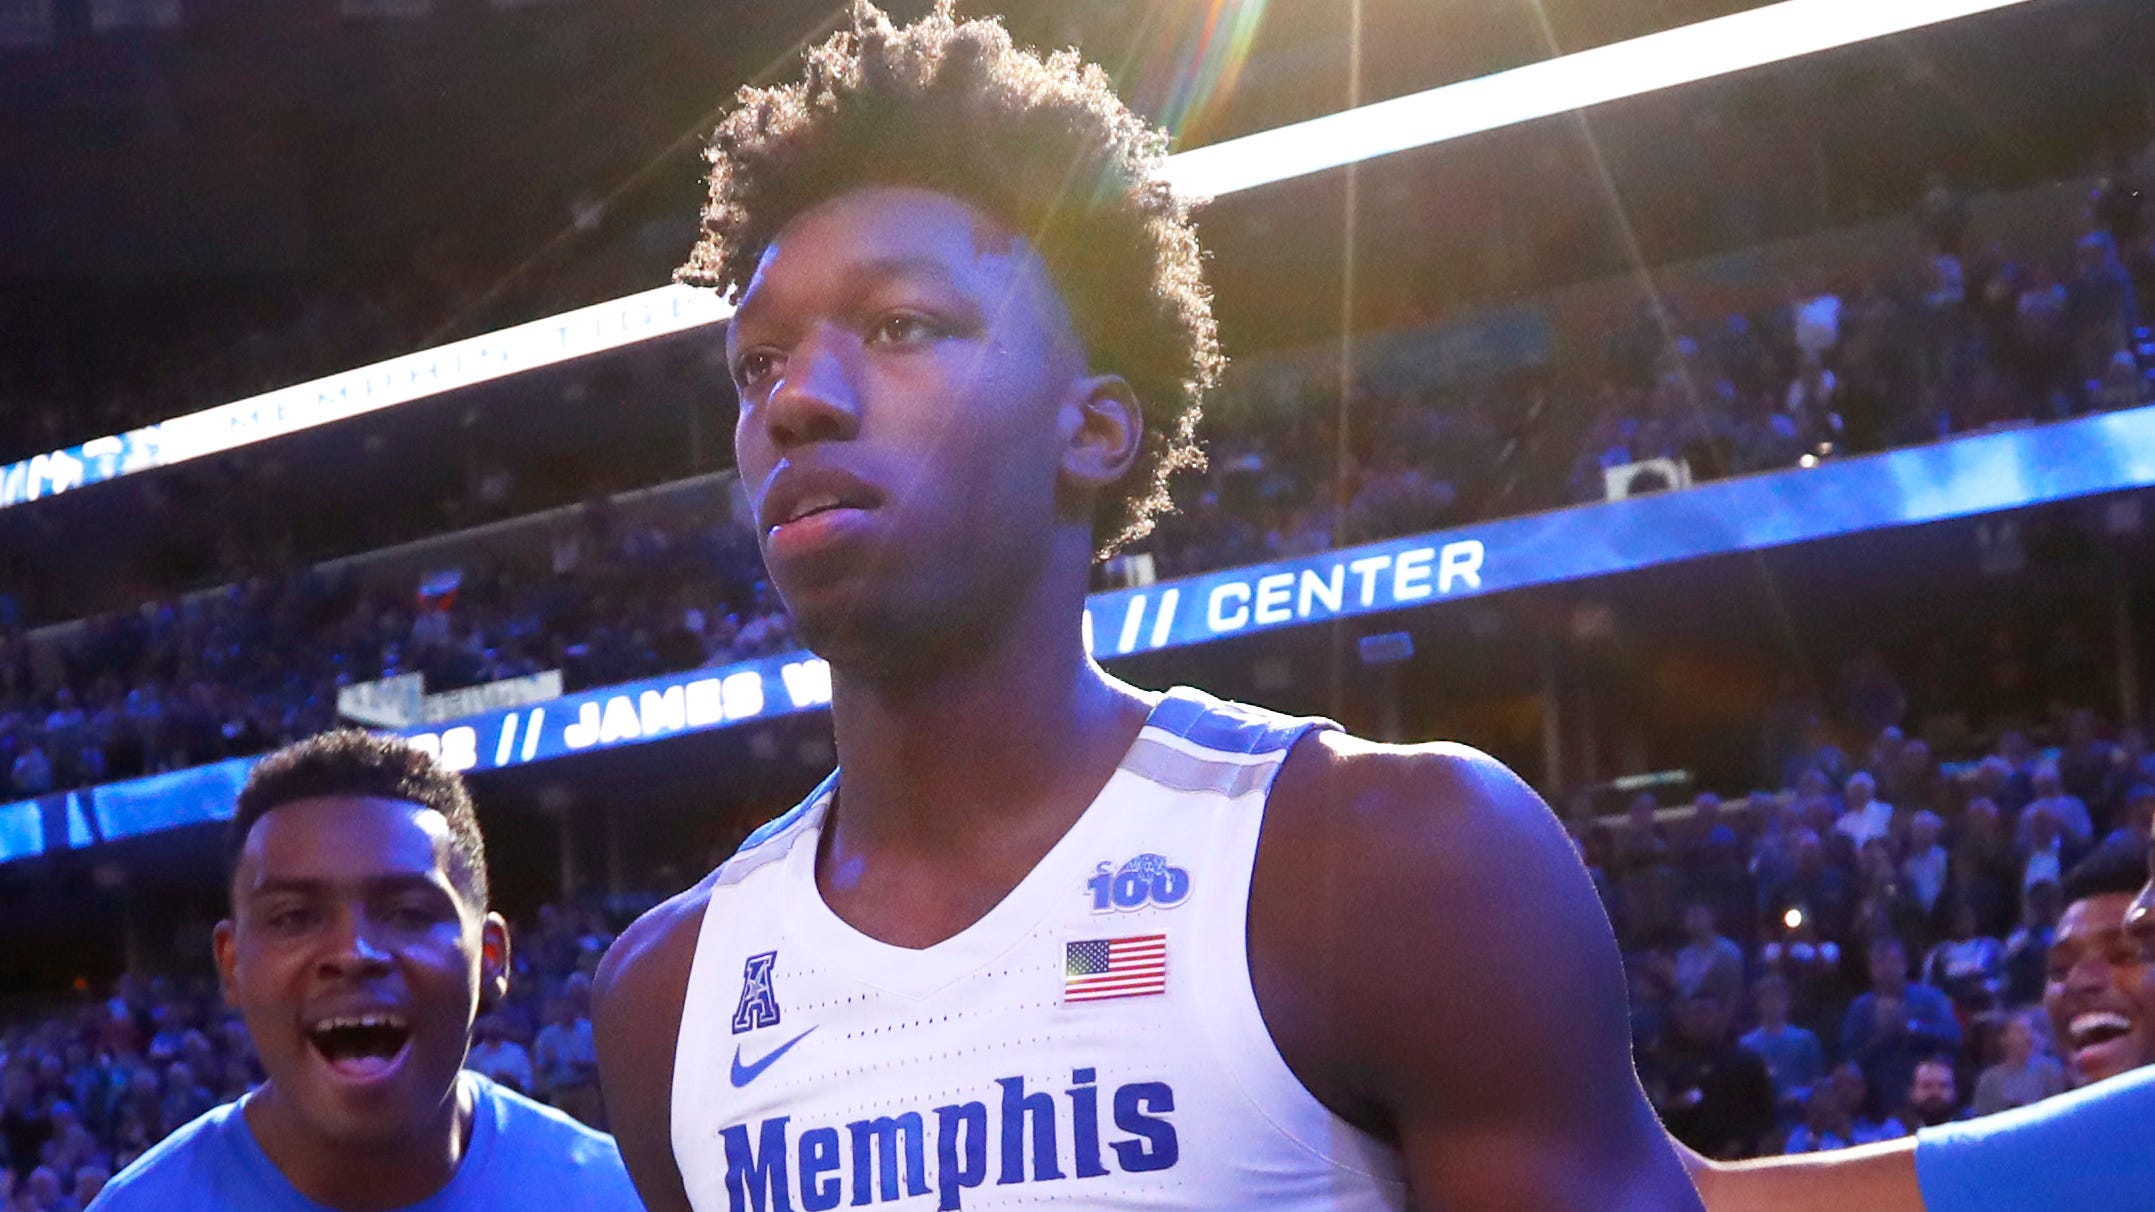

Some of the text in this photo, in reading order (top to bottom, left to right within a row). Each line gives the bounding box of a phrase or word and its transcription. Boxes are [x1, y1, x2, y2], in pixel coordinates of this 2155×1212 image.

[230, 345, 509, 433] MEMPHIS
[1207, 540, 1486, 634] CENTER
[565, 672, 763, 750] JAMES
[1087, 863, 1190, 911] 100
[732, 950, 780, 1036] A
[718, 1067, 1180, 1212] Memphis
